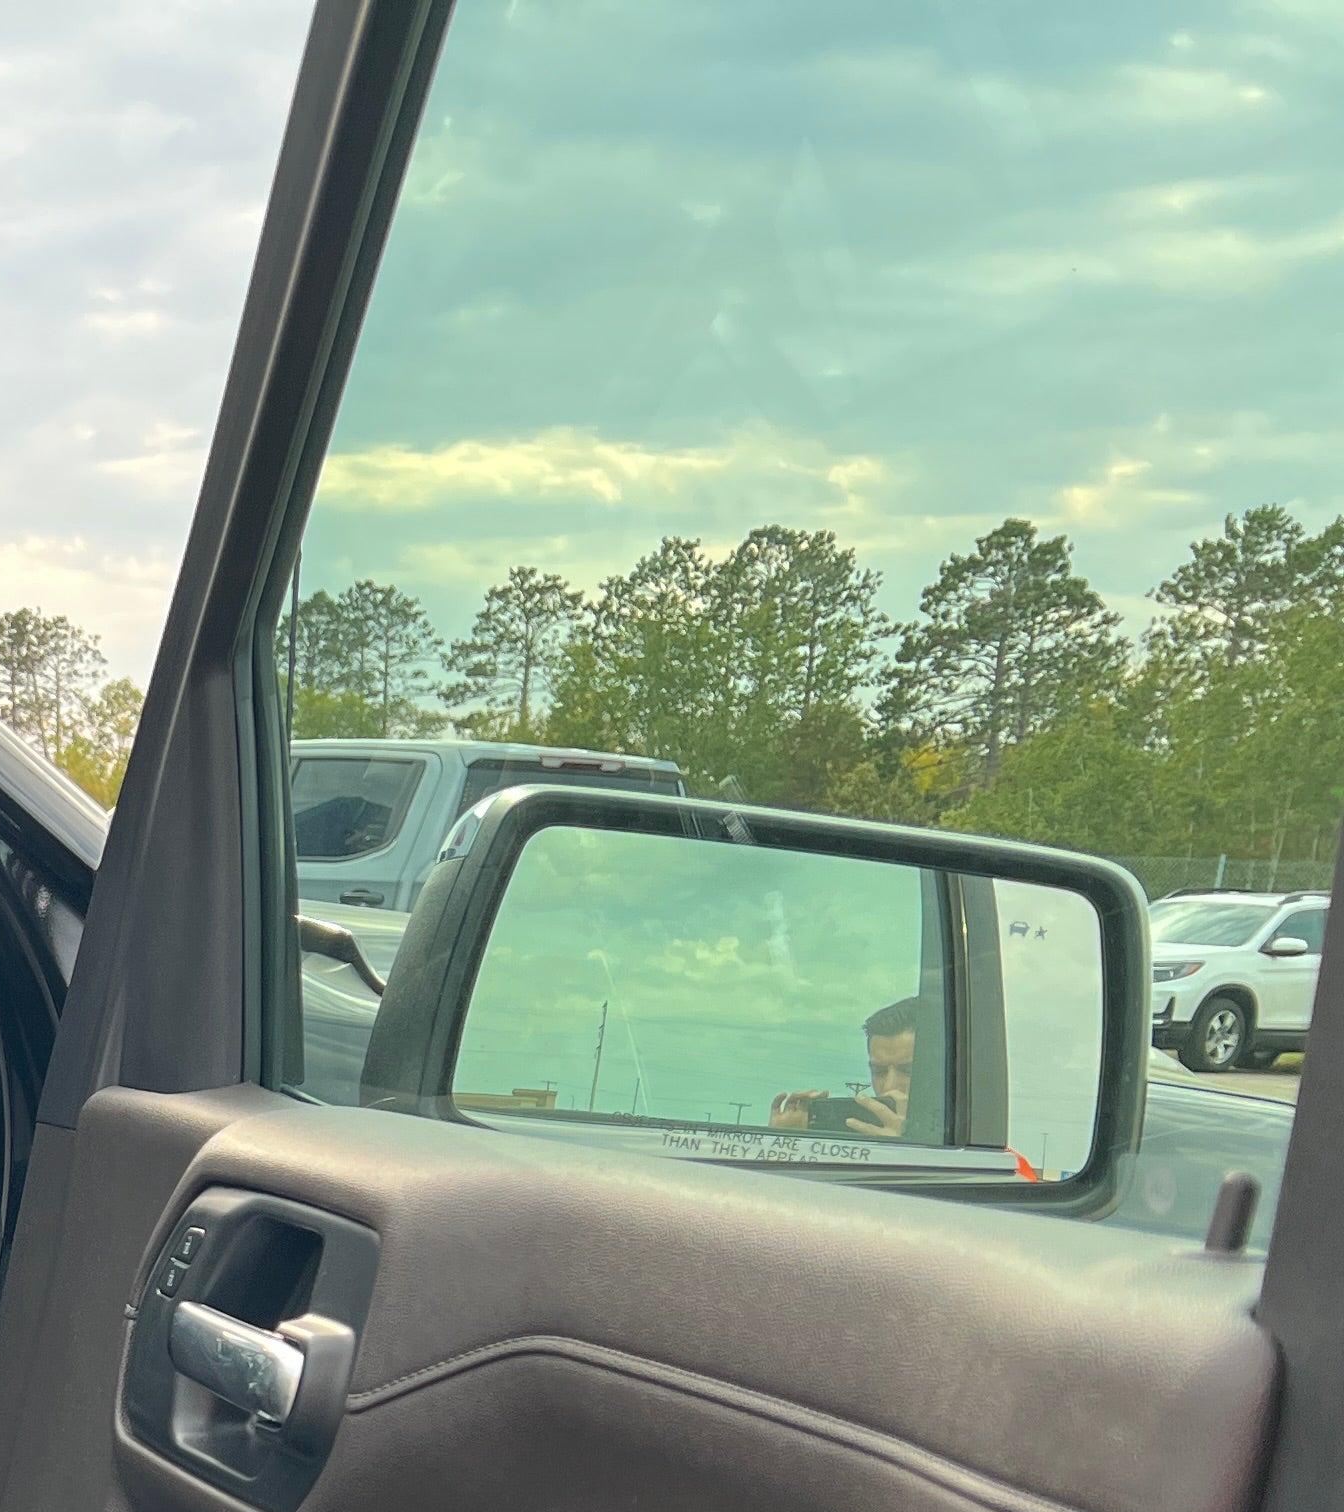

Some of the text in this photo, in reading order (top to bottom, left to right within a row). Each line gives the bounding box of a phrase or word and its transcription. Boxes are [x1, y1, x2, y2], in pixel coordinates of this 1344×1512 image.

[662, 1133, 701, 1151] THAN
[712, 1141, 751, 1158] THEY
[771, 1136, 801, 1151] ARE
[811, 1141, 871, 1161] CLOSER
